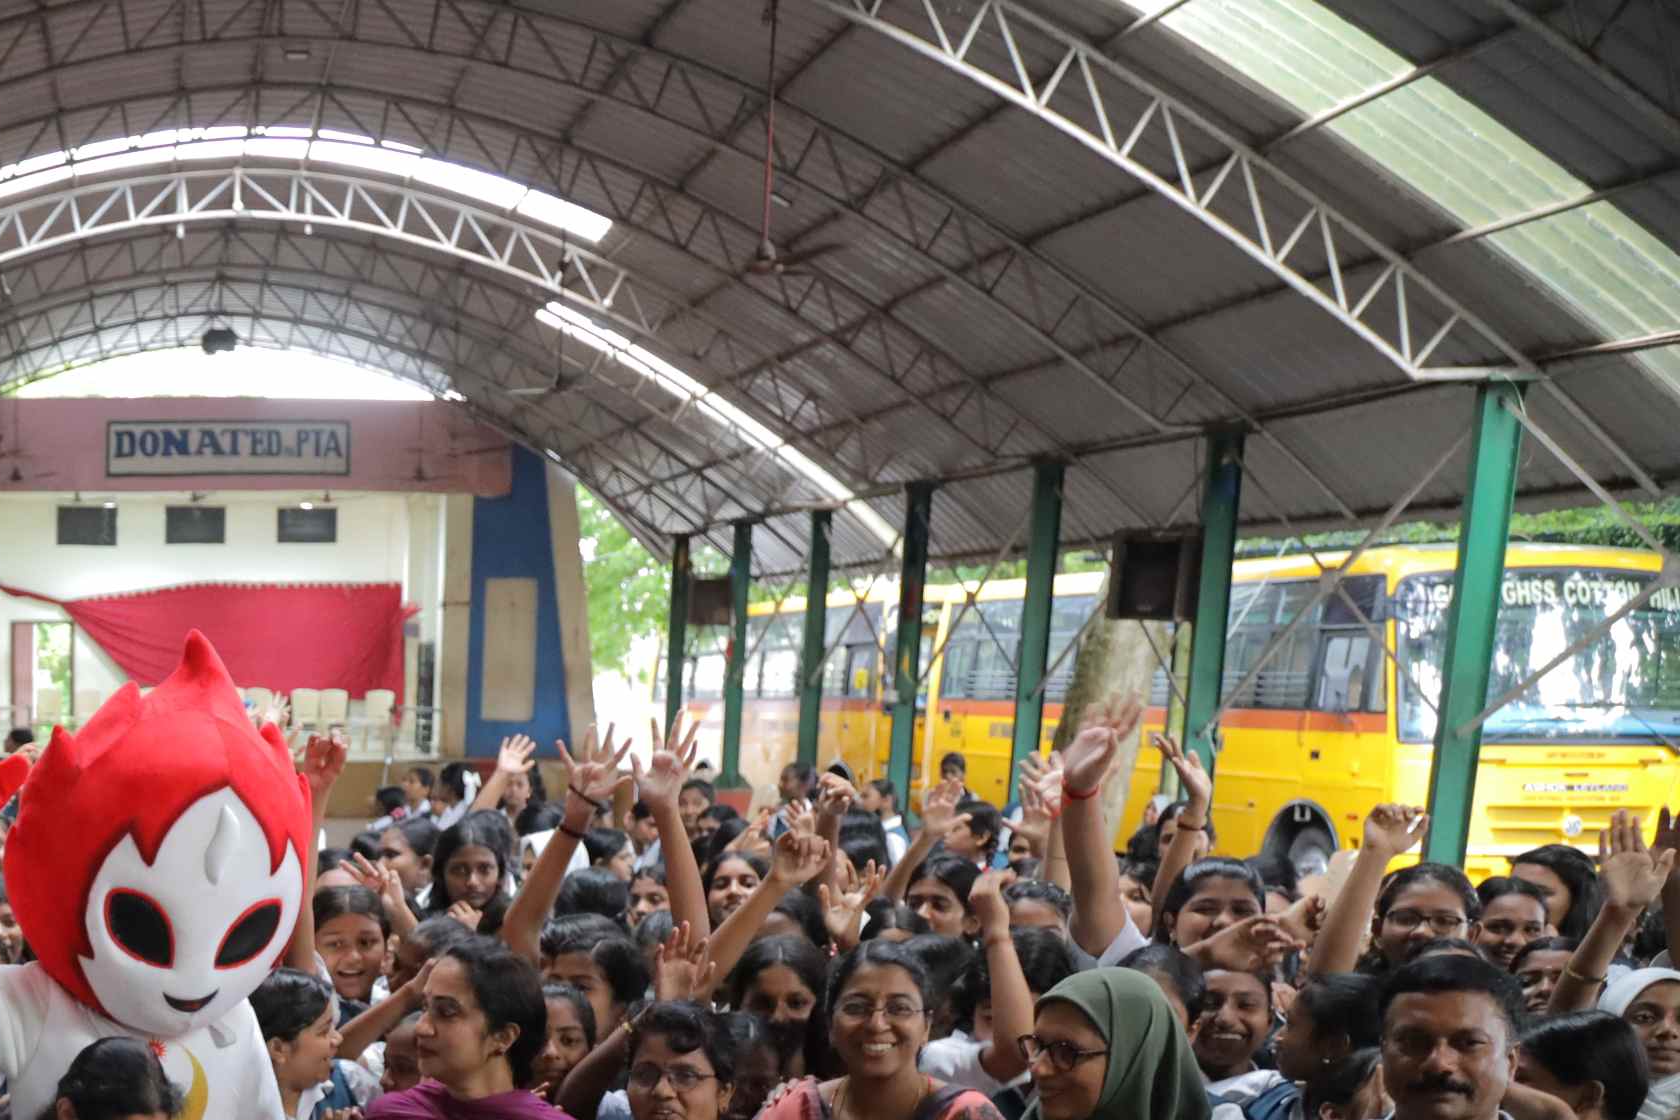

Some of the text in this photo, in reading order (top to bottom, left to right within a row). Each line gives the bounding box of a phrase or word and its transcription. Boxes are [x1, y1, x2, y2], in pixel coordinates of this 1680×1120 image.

[114, 429, 343, 458] DONATED PTA
[1502, 578, 1556, 606] GHSS
